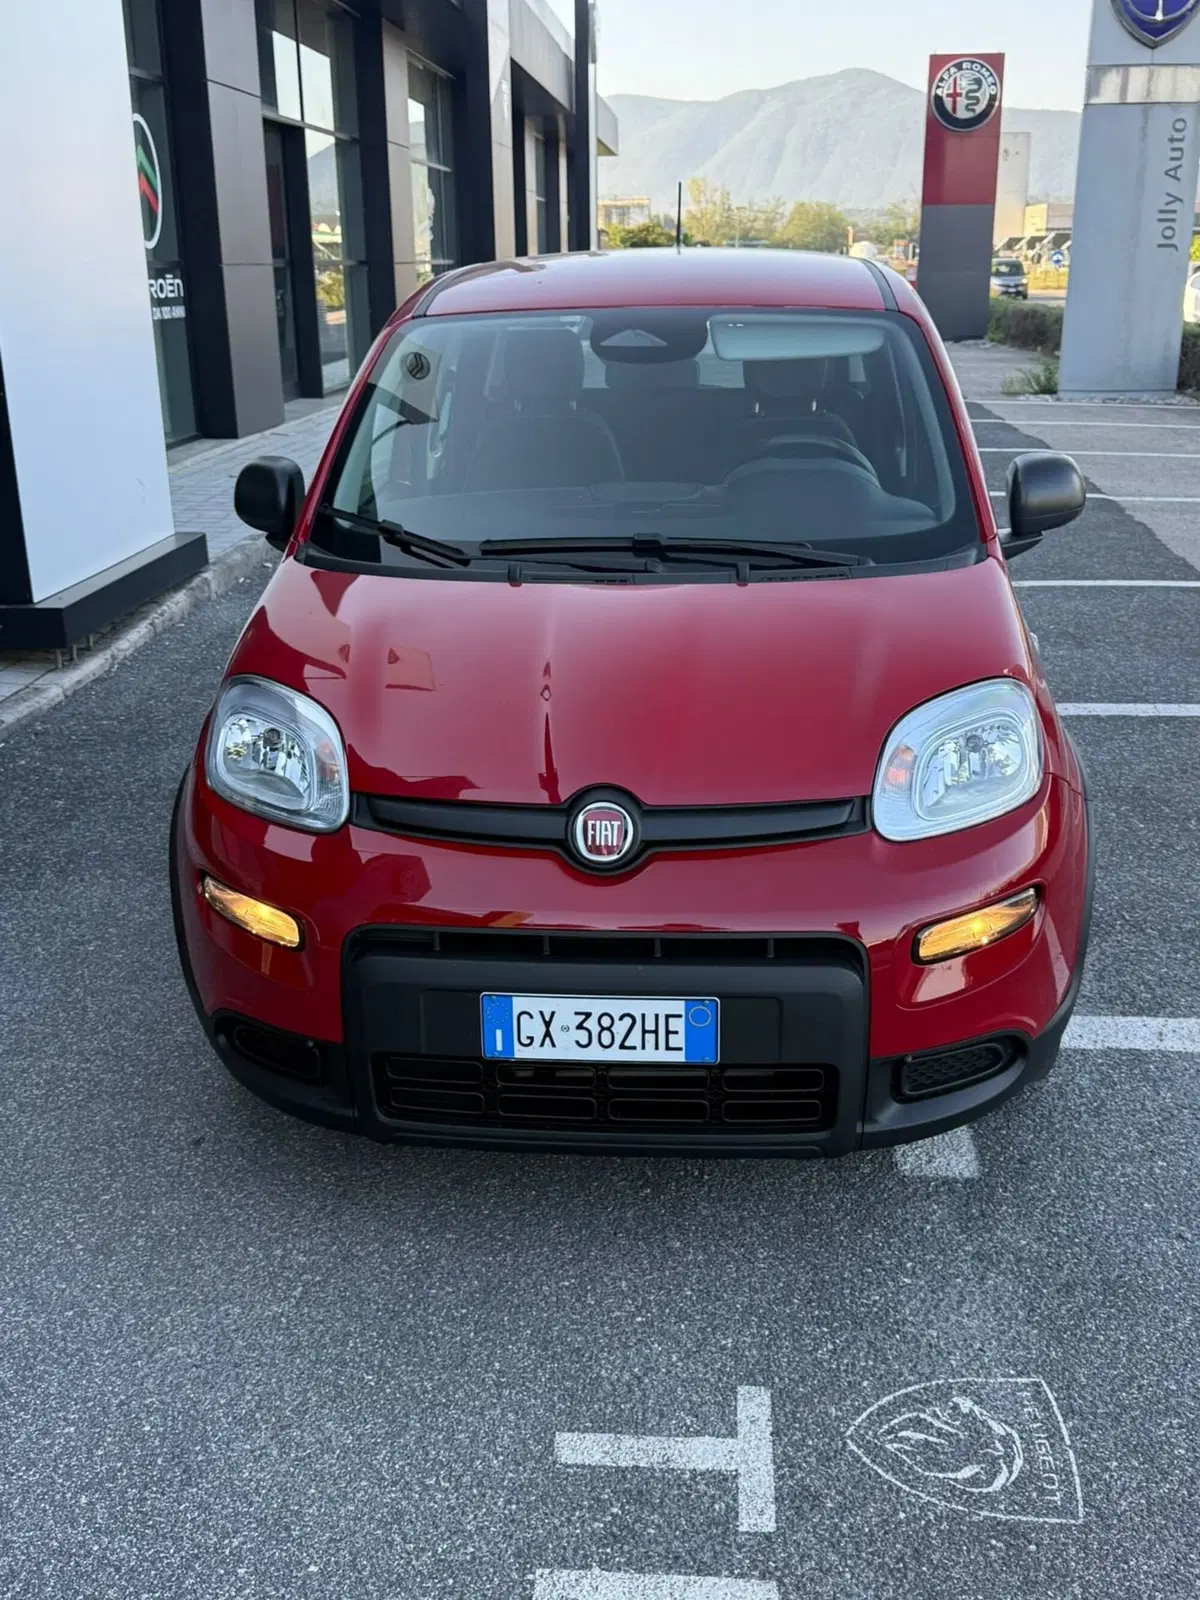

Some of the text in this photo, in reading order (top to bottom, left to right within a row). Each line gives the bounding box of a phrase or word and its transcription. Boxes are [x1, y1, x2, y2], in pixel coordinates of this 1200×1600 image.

[936, 62, 997, 96] ALFA ROMEO
[1157, 117, 1188, 251] Jolly Auto
[148, 274, 184, 299] ROËN
[587, 820, 621, 846] FIAT
[516, 1010, 556, 1048] GX
[573, 1011, 684, 1052] 382HE
